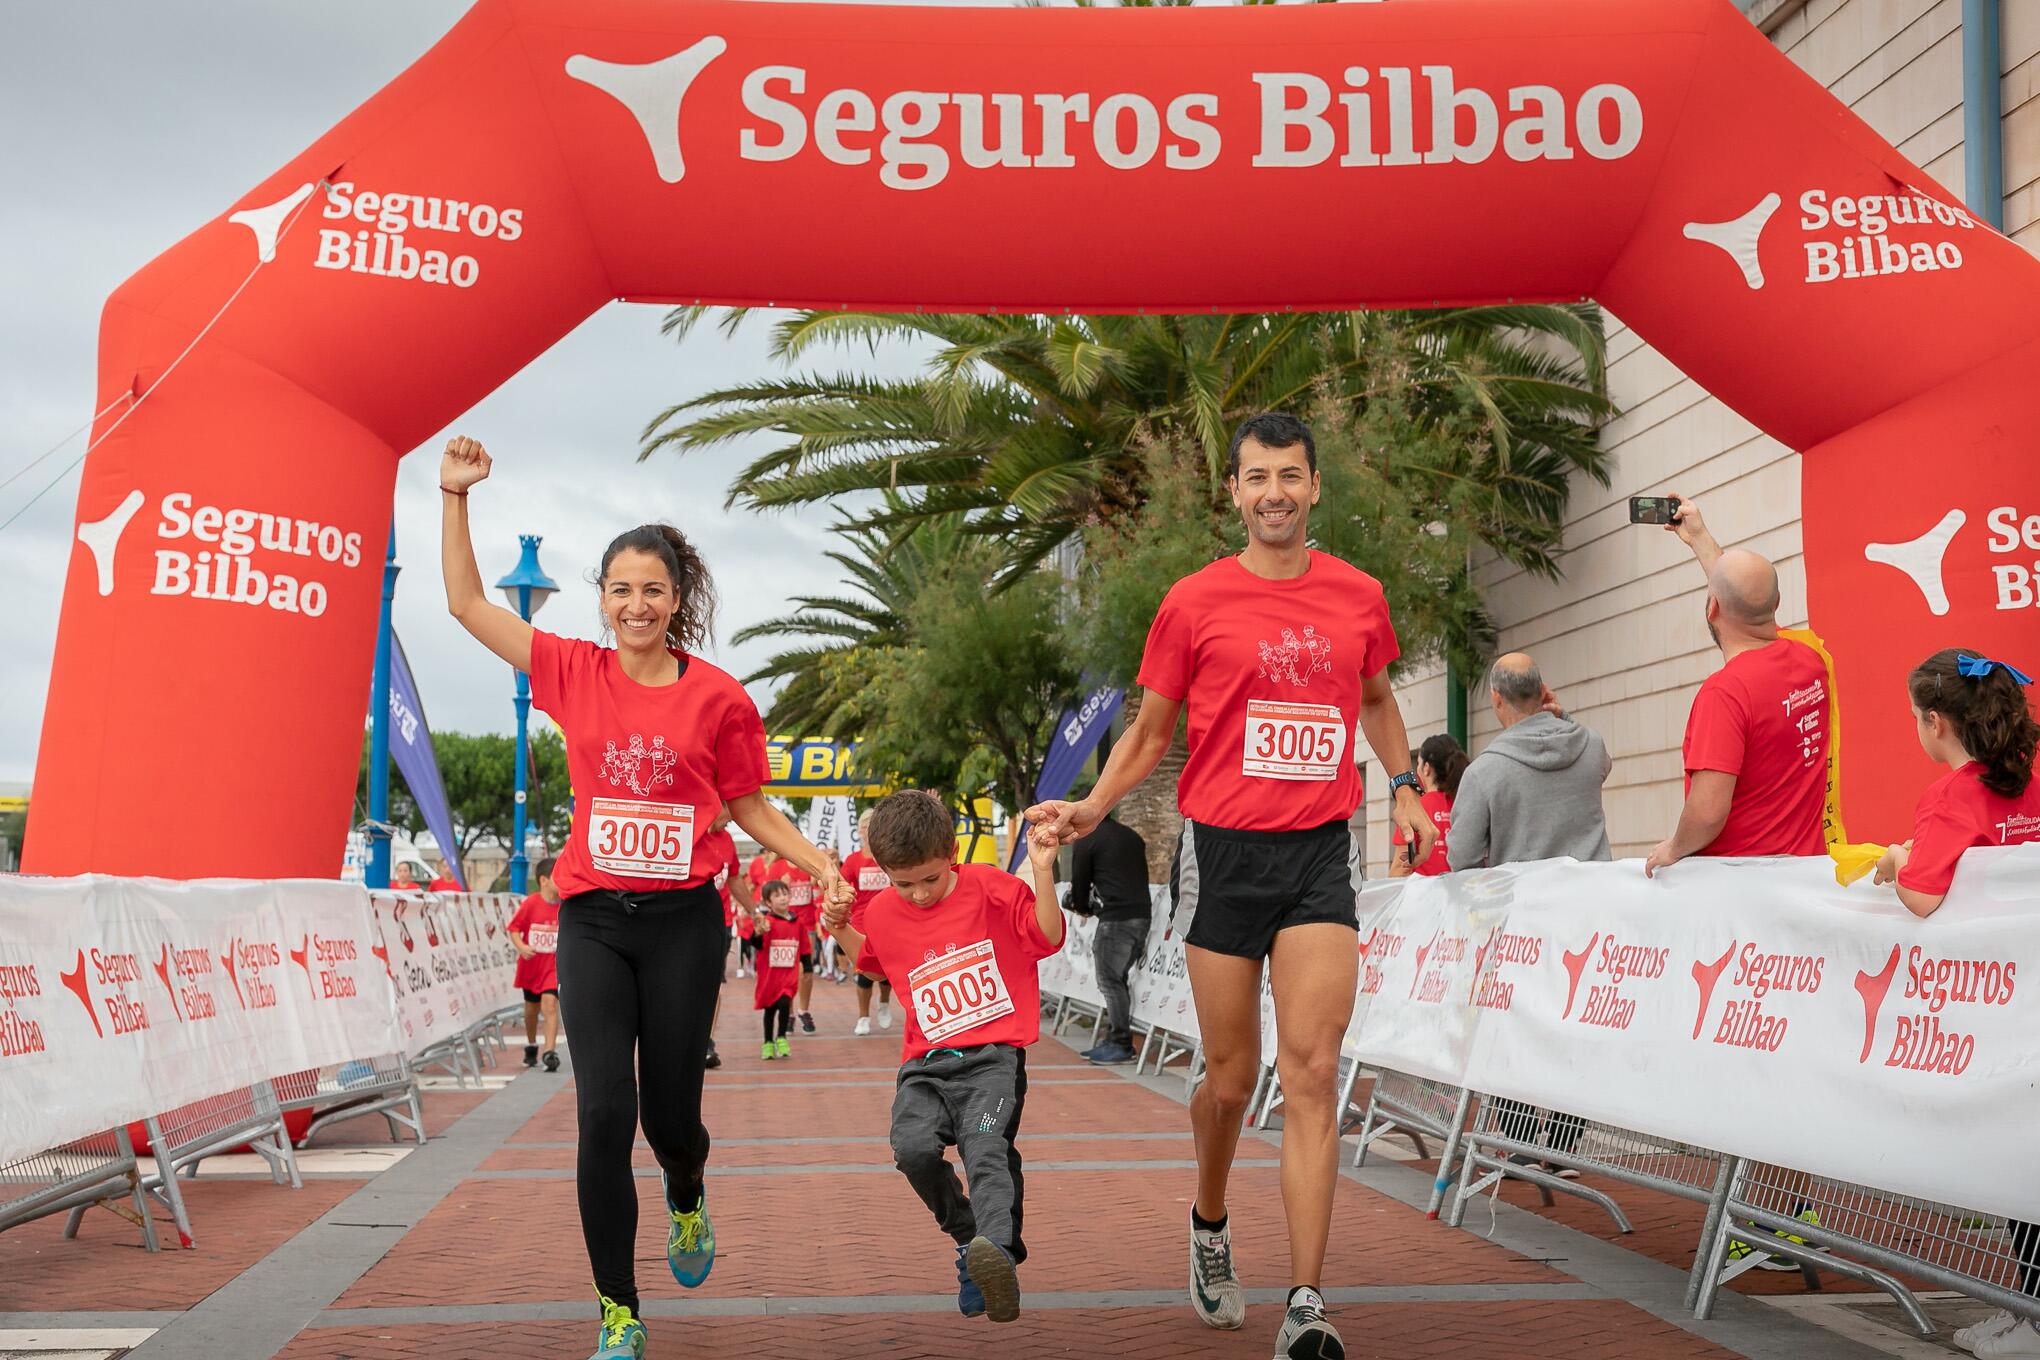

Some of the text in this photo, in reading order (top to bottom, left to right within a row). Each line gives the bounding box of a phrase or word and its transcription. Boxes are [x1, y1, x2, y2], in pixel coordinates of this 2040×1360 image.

[740, 64, 1643, 191] Seguros Bilbao
[322, 182, 524, 242] Seguros
[1800, 189, 1975, 235] Seguros
[313, 229, 480, 288] Bilbao
[1803, 234, 1963, 283] Bilbao
[156, 493, 362, 568] Seguros
[150, 549, 328, 618] Bilbao
[1256, 722, 1337, 763] 3005
[598, 819, 681, 861] 3005
[1995, 822, 2006, 844] 7
[533, 933, 557, 948] 300
[1596, 933, 1670, 984] Seguros
[921, 964, 998, 1024] 3005
[1733, 942, 1825, 999] Seguros
[1904, 945, 2017, 1013] Seguros
[1579, 985, 1636, 1030] Bilbao
[1713, 999, 1788, 1052] Bilbao
[1884, 1014, 1975, 1076] Bilbao
